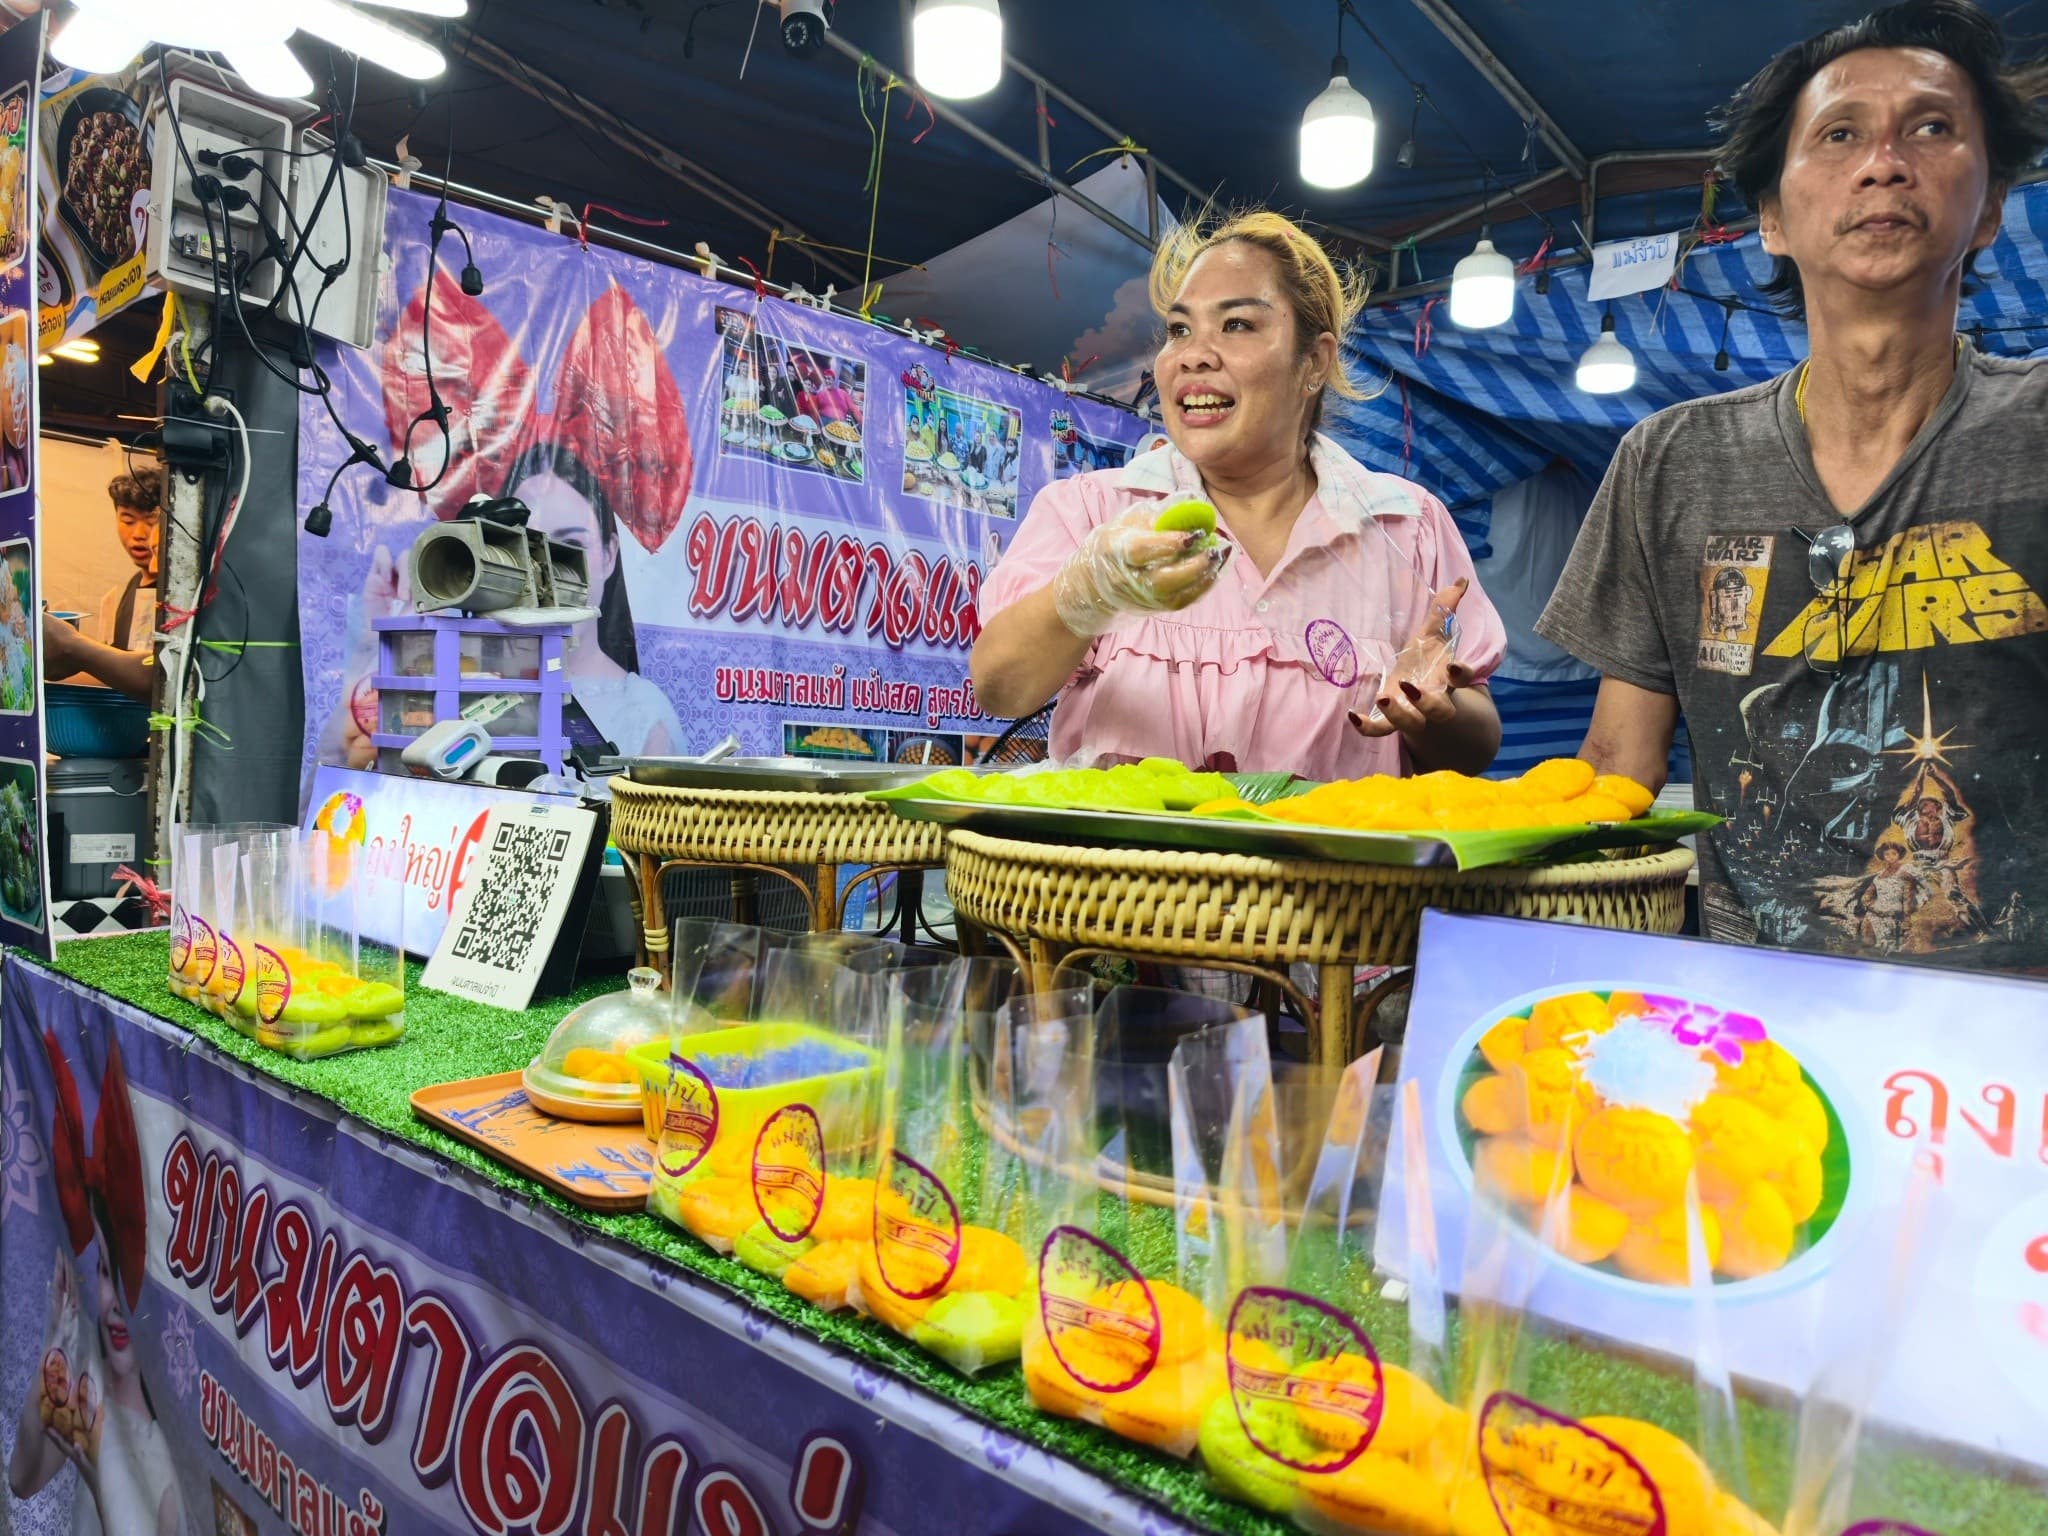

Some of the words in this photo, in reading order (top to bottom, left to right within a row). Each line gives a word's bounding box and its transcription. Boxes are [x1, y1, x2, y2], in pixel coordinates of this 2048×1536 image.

[1706, 548, 1764, 562] WARS
[1699, 646, 1726, 664] AUG
[715, 664, 845, 708] ขนมตาลแท้
[852, 668, 921, 715] แป้งสด
[1883, 1068, 2048, 1188] ถุง
